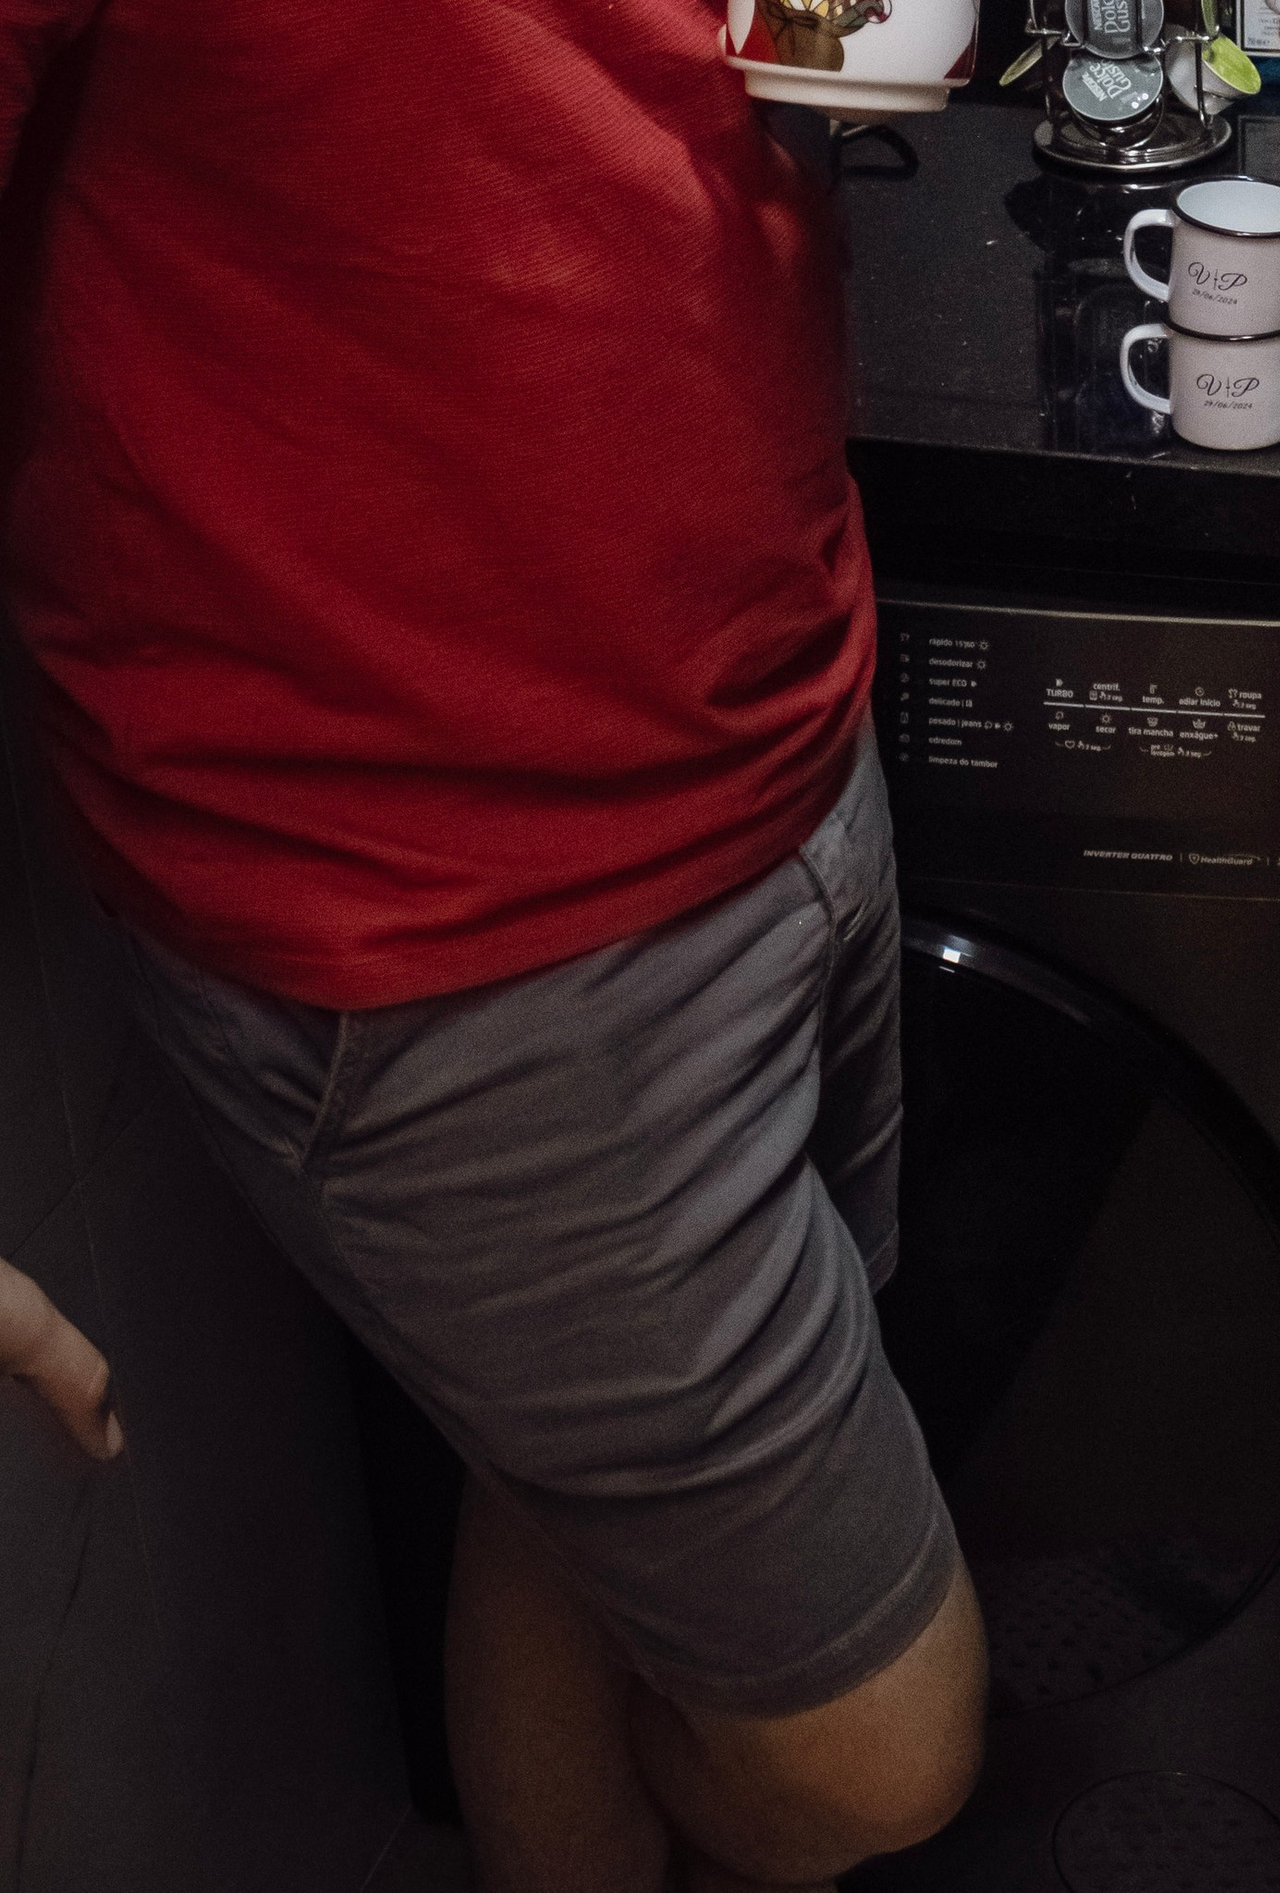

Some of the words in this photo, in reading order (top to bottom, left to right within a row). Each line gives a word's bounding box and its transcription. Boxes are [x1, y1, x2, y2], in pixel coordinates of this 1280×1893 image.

[1046, 688, 1074, 698] TURBO
[1048, 723, 1071, 731] vapor
[1095, 726, 1117, 734] secar
[1143, 729, 1174, 737] mancha
[1083, 850, 1130, 859] INVERTER
[1131, 853, 1173, 861] QUATTRO
